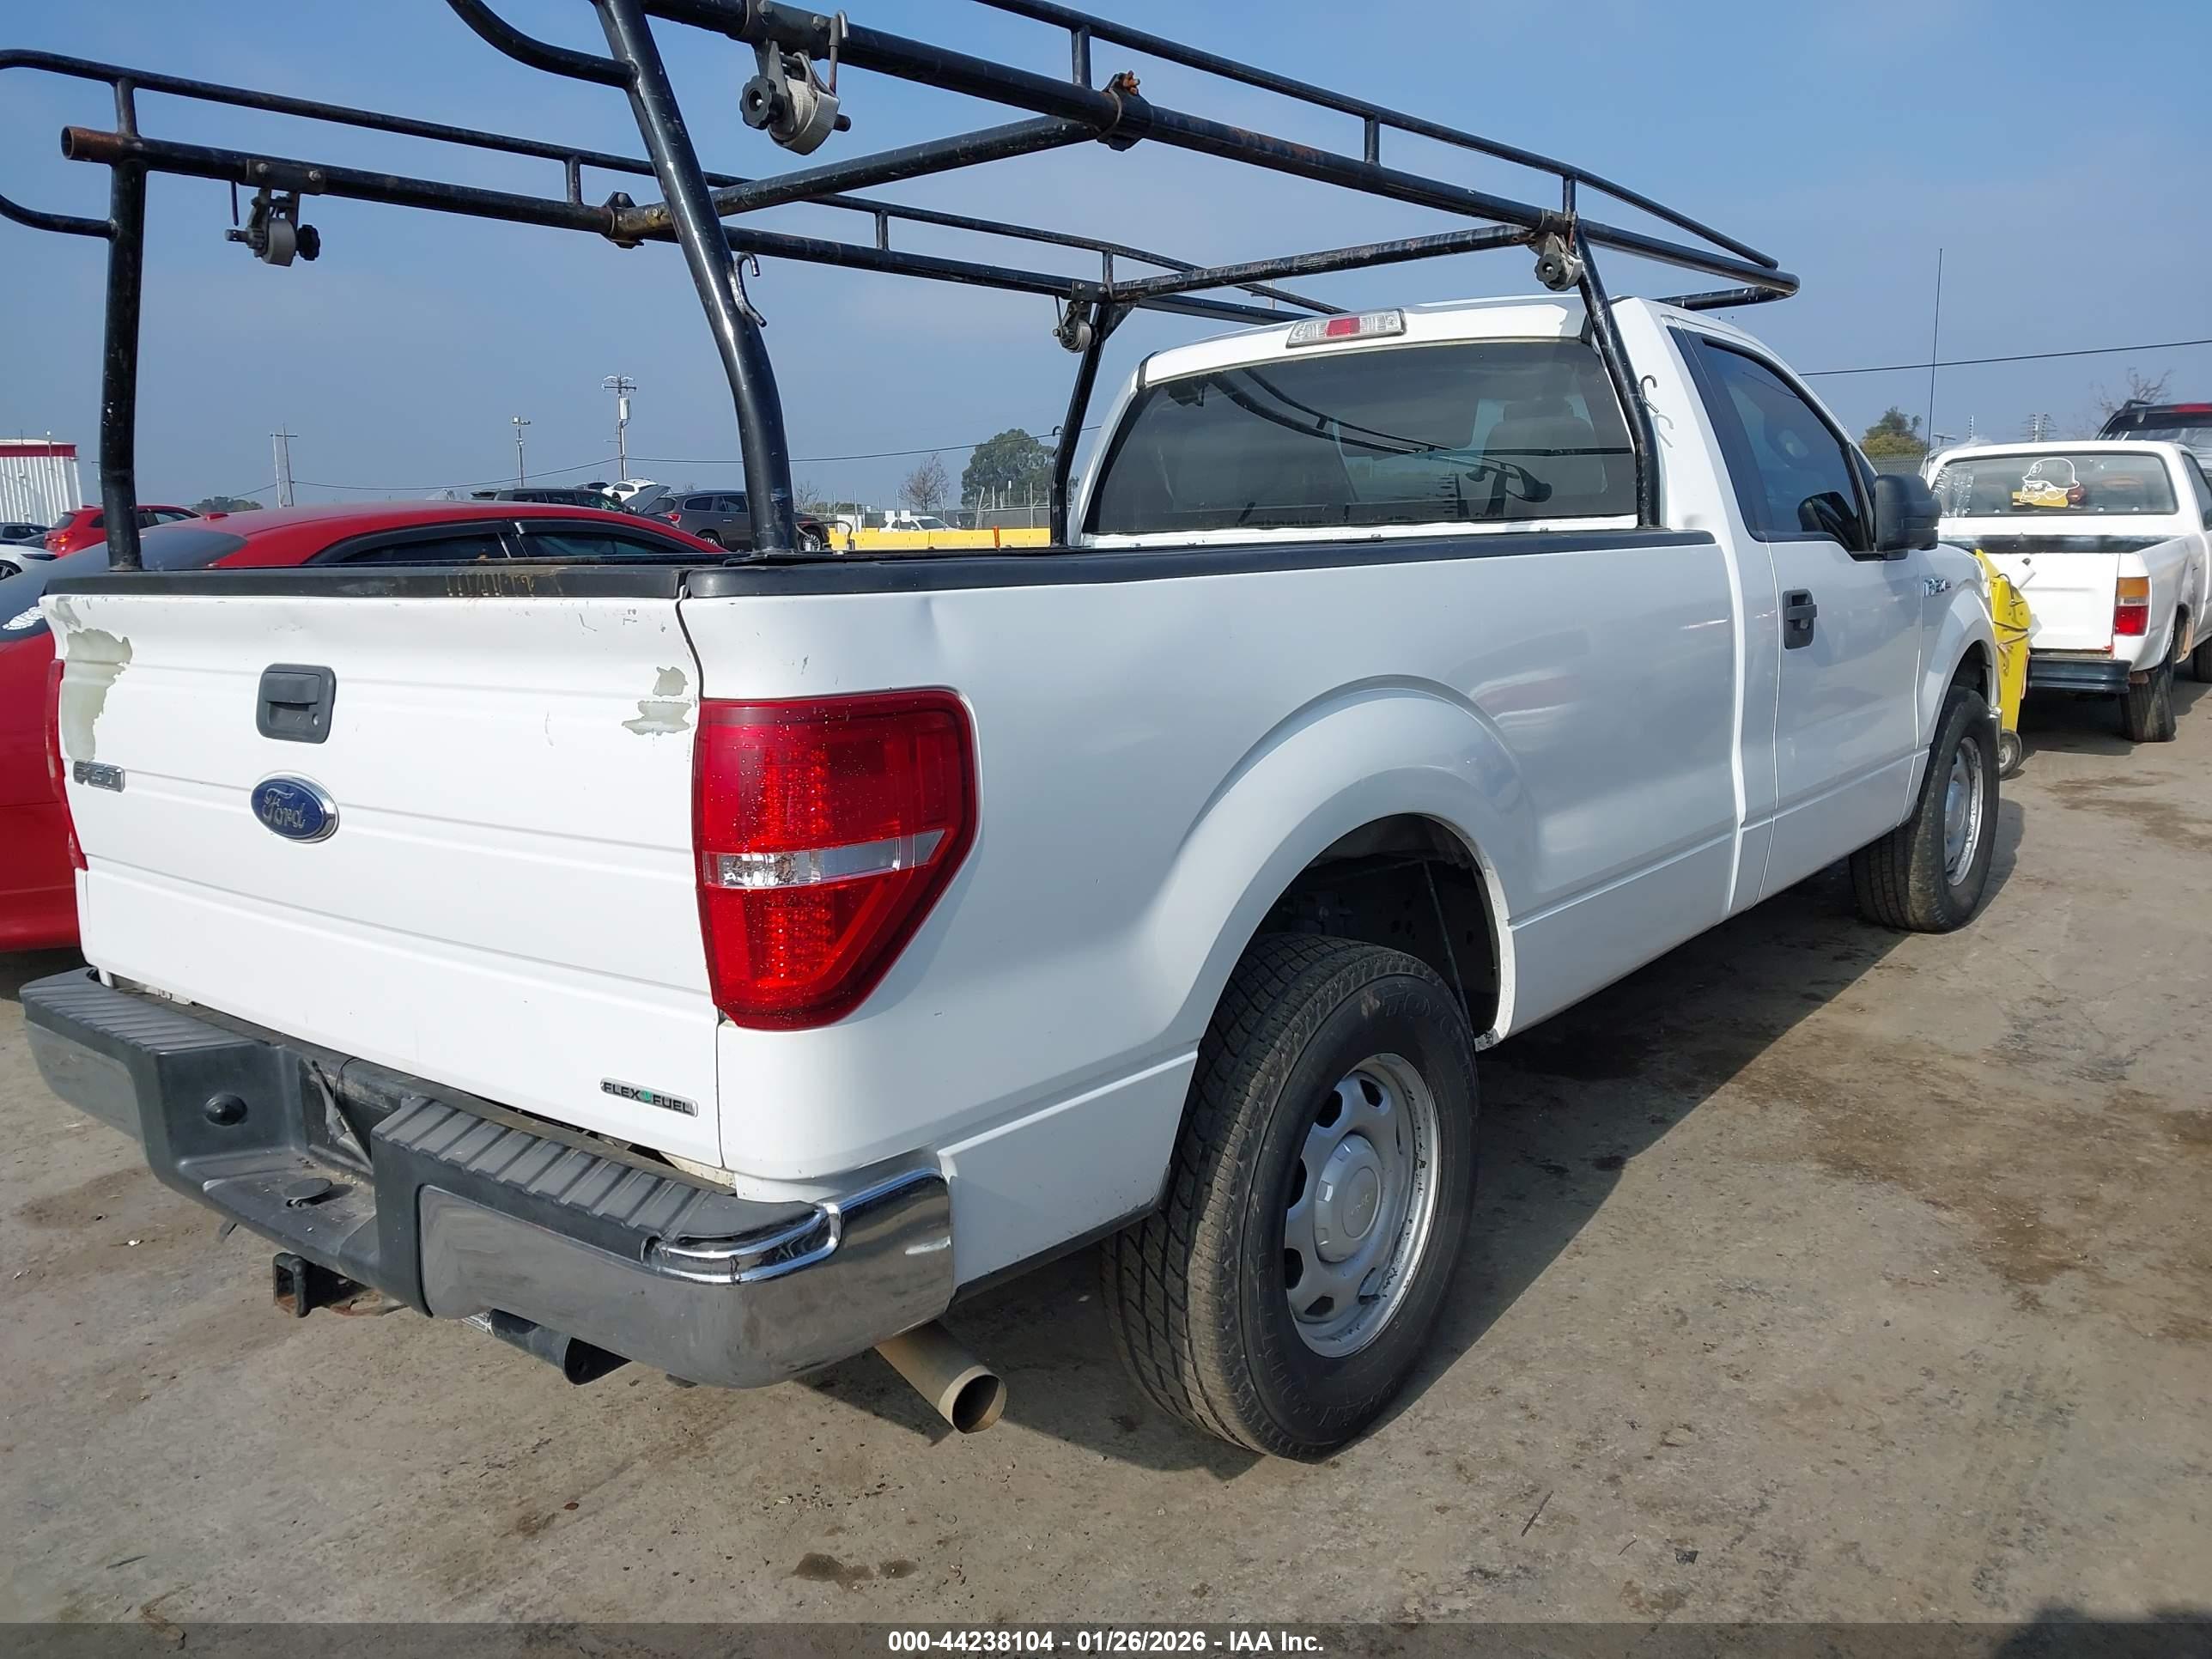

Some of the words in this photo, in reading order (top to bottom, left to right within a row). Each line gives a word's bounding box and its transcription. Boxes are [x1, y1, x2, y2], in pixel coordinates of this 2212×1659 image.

[261, 787, 307, 830] Ford
[603, 1081, 641, 1102] FLEX
[653, 1093, 692, 1114] FUEL
